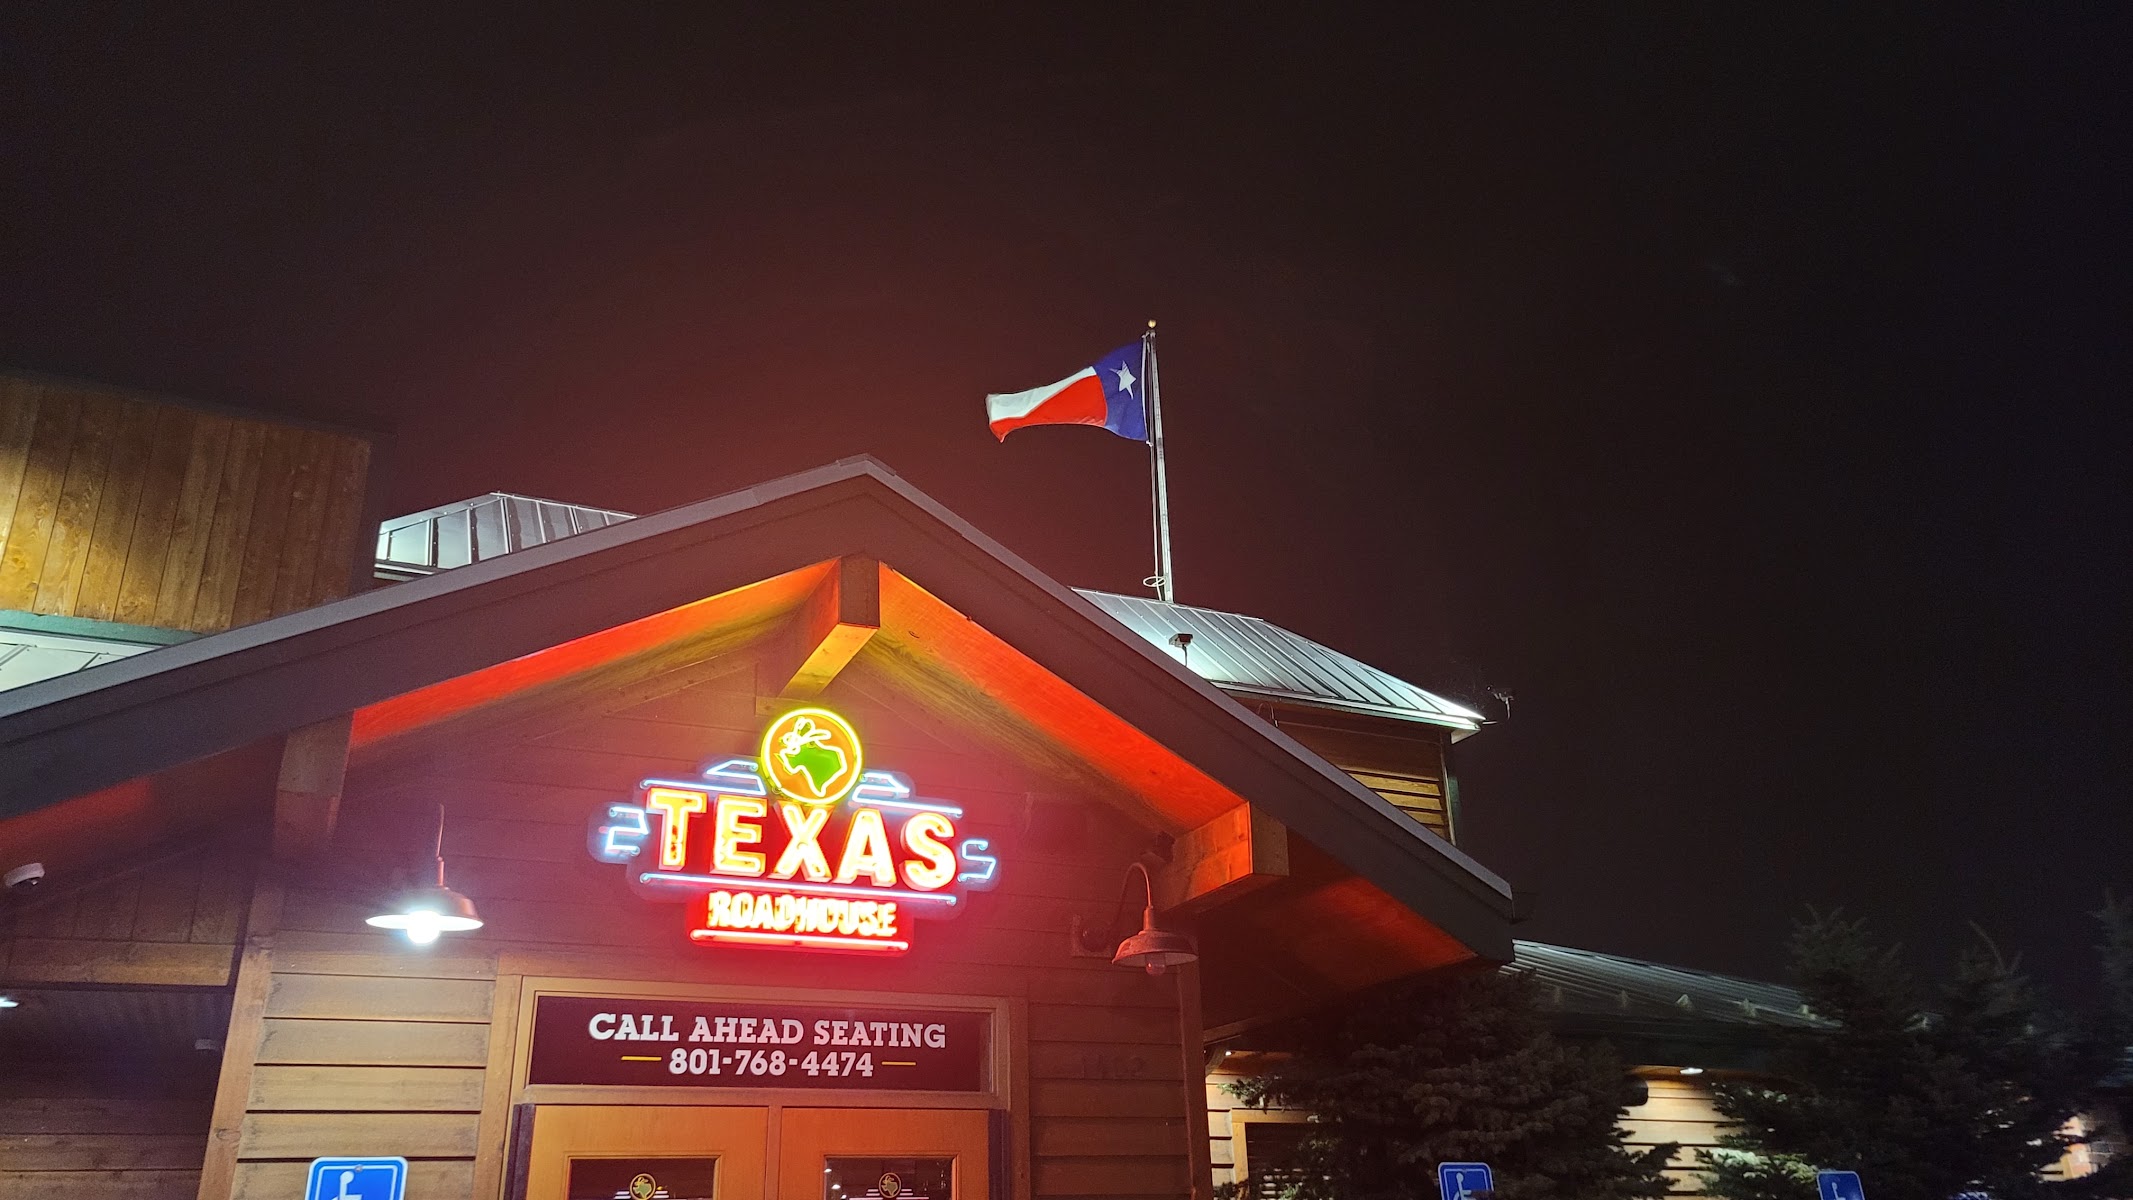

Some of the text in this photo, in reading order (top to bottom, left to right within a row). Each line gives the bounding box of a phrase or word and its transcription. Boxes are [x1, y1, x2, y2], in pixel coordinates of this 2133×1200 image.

[645, 787, 958, 890] TEXAS
[707, 891, 898, 938] ROADHOUSE
[588, 1012, 946, 1048] CALL AHEAD SEATING
[668, 1047, 874, 1077] 801-768-4474
